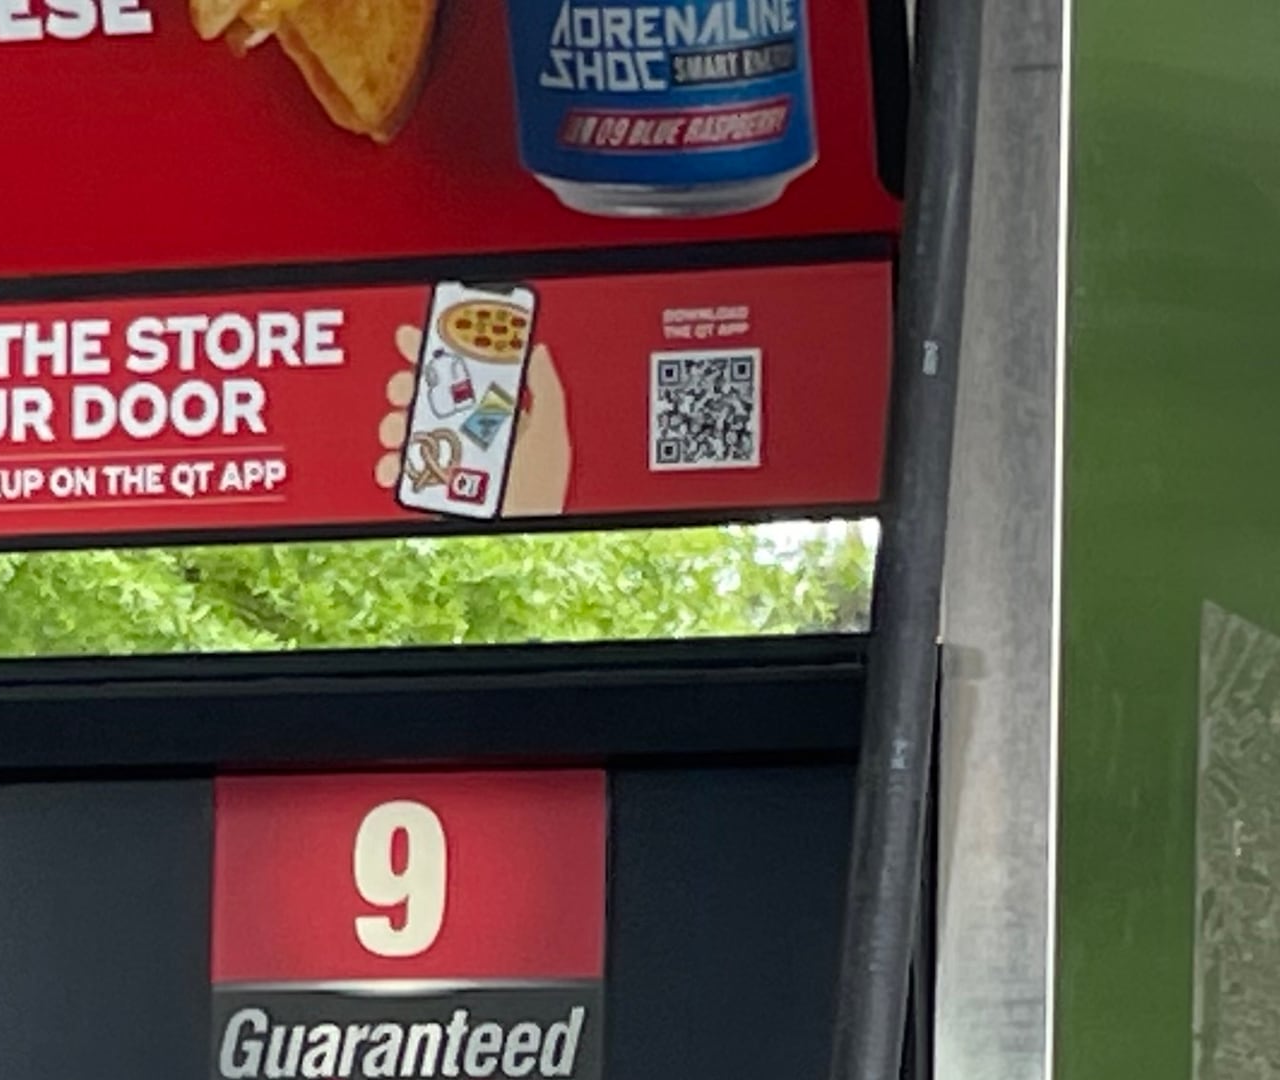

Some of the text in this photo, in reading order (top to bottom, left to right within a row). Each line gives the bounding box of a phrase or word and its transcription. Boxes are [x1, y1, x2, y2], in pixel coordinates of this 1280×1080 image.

[552, 0, 796, 46] ADRENALINE
[539, 51, 667, 90] SHOC
[125, 309, 345, 374] STORE
[72, 377, 267, 440] DOOR
[49, 466, 96, 498] ON
[102, 464, 165, 496] THE
[171, 461, 215, 498] QT
[220, 459, 287, 492] APP
[354, 800, 448, 957] 9
[220, 1006, 585, 1080] Guaranteed
